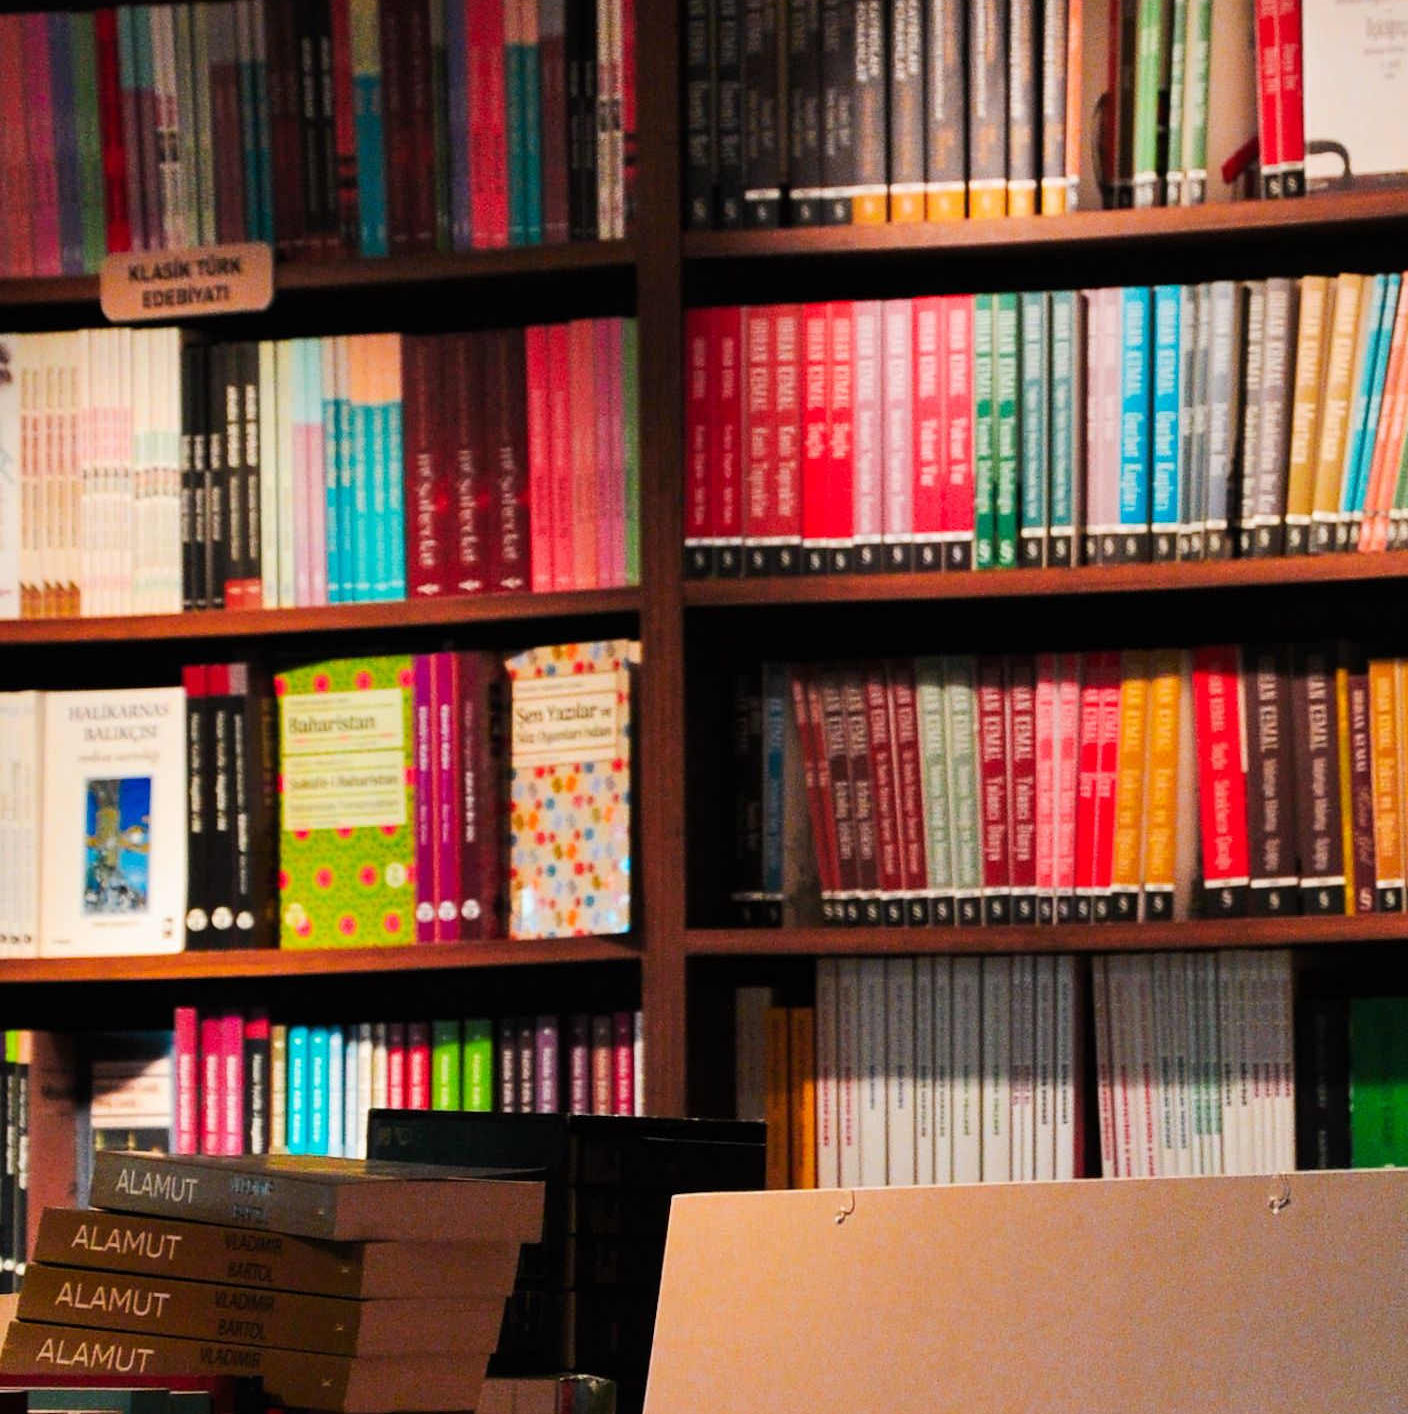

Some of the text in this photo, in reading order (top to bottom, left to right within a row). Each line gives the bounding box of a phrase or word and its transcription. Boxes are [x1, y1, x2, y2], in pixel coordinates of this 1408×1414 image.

[128, 255, 241, 283] KLASİK TÜRK
[142, 284, 230, 308] EDEBİYATI
[115, 1167, 198, 1204] ALAMUT
[70, 1224, 183, 1261] ALAMUT
[223, 1234, 284, 1256] VLADIMIR
[226, 1261, 275, 1283] BARTOL
[54, 1282, 171, 1318] ALAMUT
[214, 1291, 276, 1313] VLADIMIR
[218, 1319, 266, 1341] BARTOL
[35, 1339, 155, 1375] ALAMUT
[200, 1347, 262, 1369] VLADIMIR
